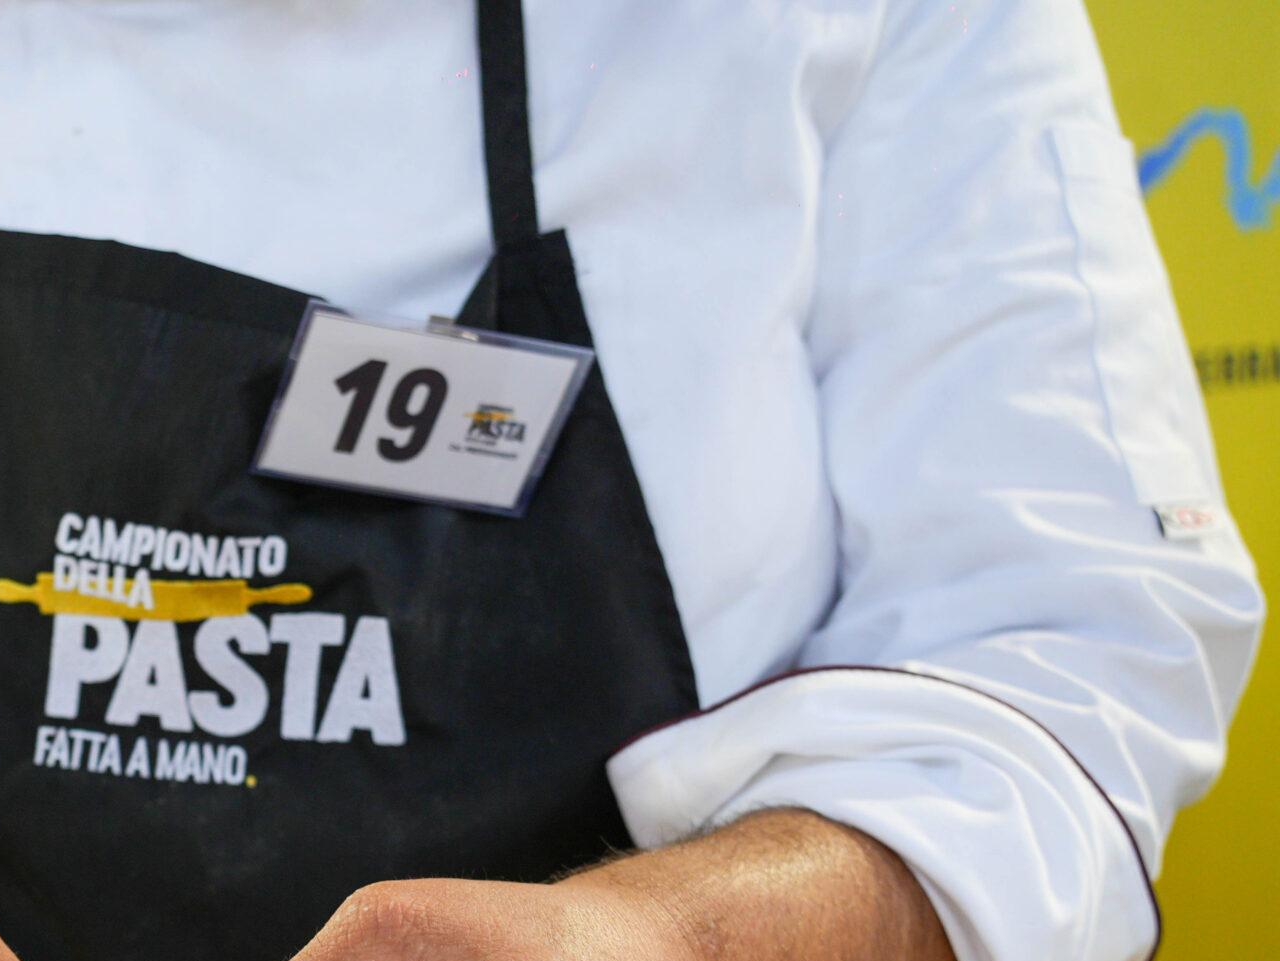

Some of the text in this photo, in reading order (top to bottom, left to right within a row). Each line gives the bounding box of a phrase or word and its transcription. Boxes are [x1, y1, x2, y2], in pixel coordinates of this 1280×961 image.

[333, 358, 449, 463] 19
[55, 512, 287, 579] CAMPIONATO
[53, 554, 155, 610] DELLA
[44, 611, 407, 747] PASTA
[33, 725, 121, 776] FATTA
[125, 736, 151, 779] A
